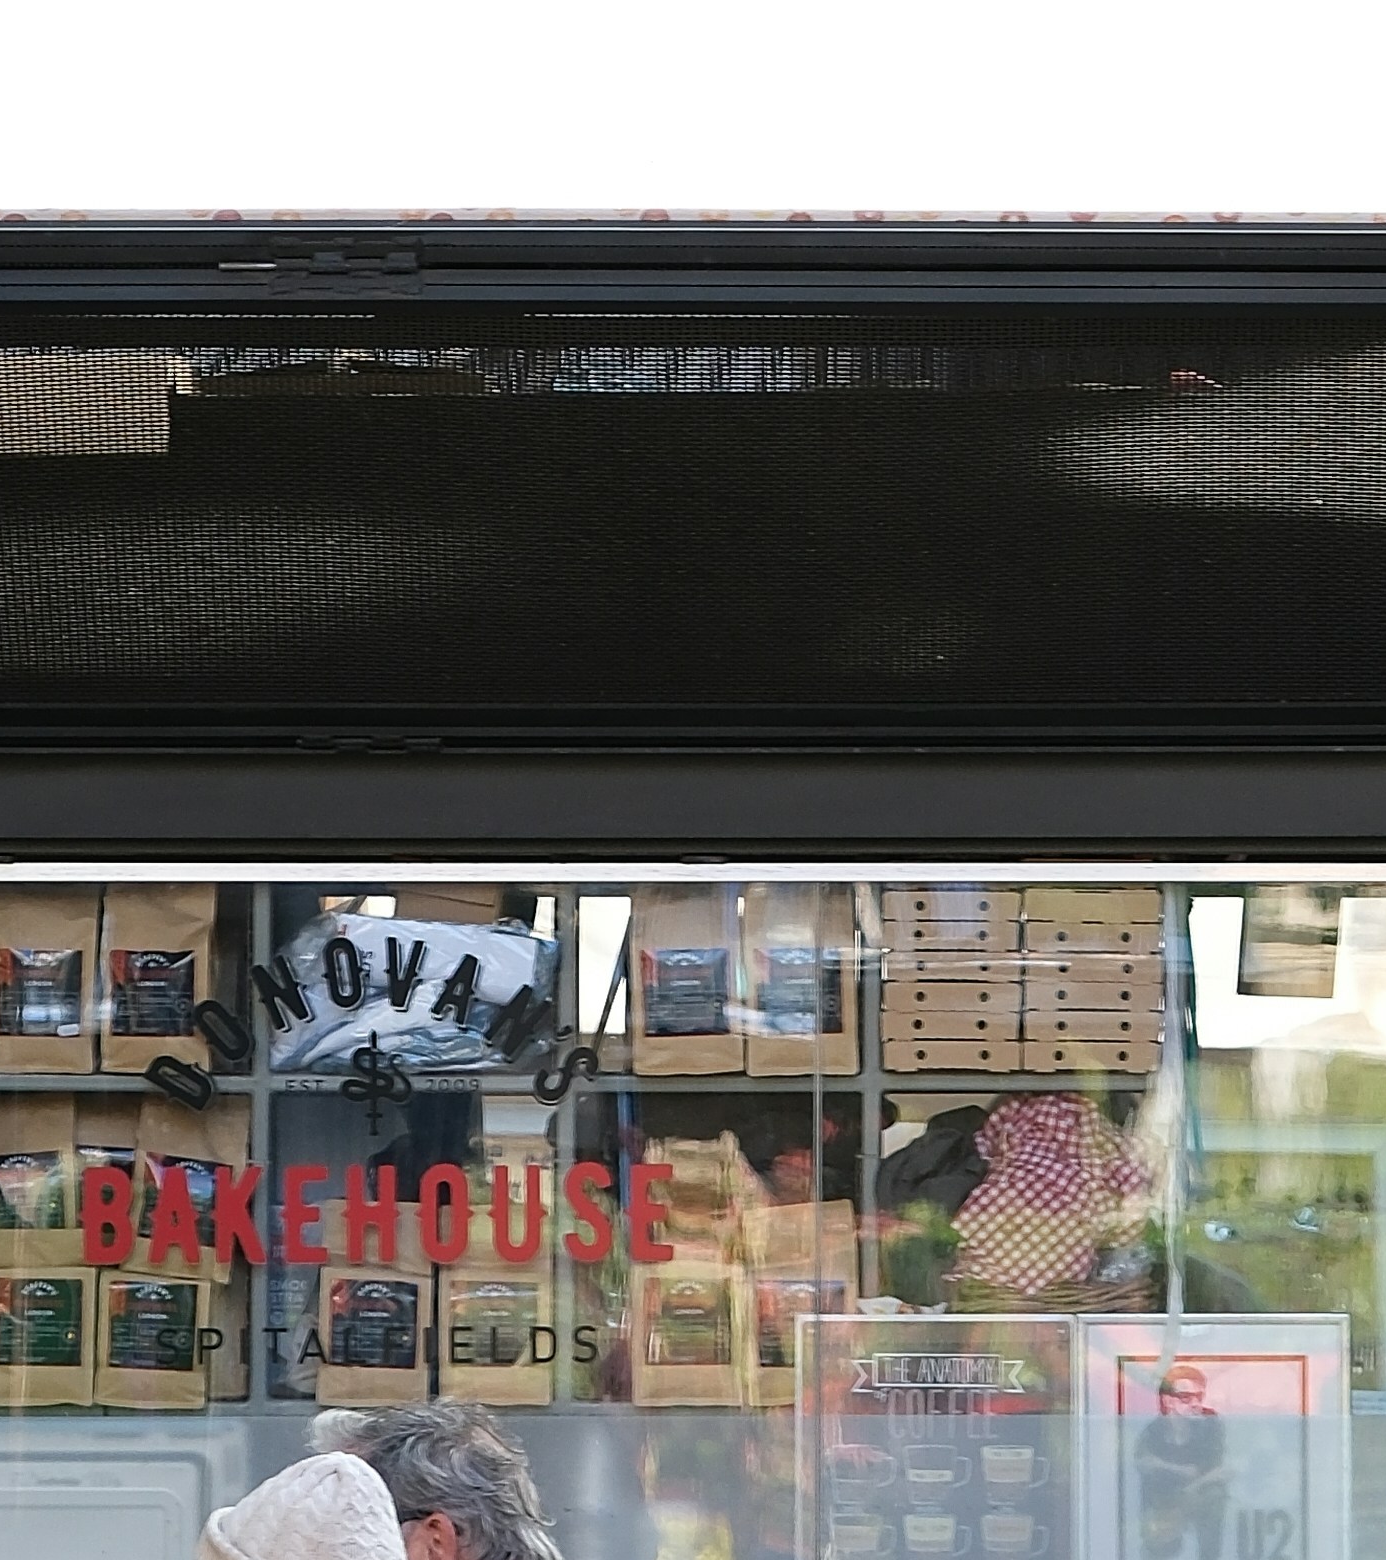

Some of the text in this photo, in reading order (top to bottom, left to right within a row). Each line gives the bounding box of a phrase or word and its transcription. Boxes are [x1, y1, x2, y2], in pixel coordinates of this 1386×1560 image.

[142, 936, 600, 1111] DONOVAN'S
[284, 1078, 480, 1092] EST 2009
[79, 1163, 674, 1265] BAKEHOUSE
[155, 1325, 599, 1366] SPITALFIELDS
[887, 1388, 1000, 1439] COFFEE
